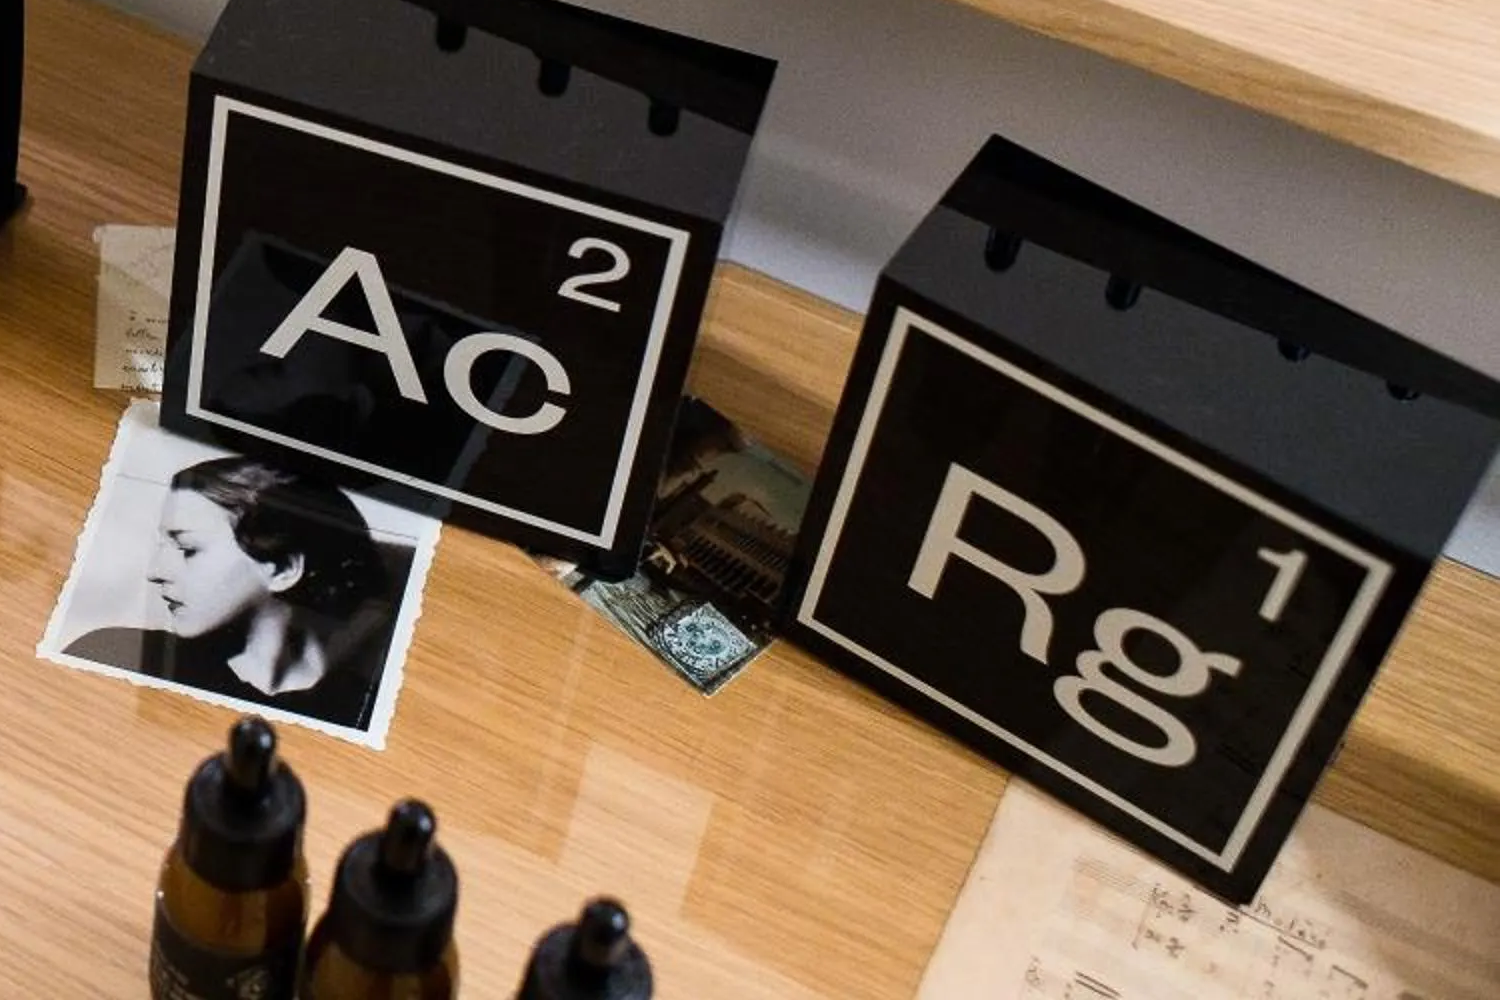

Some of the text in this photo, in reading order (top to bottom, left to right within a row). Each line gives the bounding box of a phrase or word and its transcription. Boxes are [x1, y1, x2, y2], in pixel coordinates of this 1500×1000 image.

[258, 245, 572, 436] Ac
[557, 237, 632, 313] 2
[907, 461, 1244, 768] Rg
[1256, 546, 1309, 623] 1
